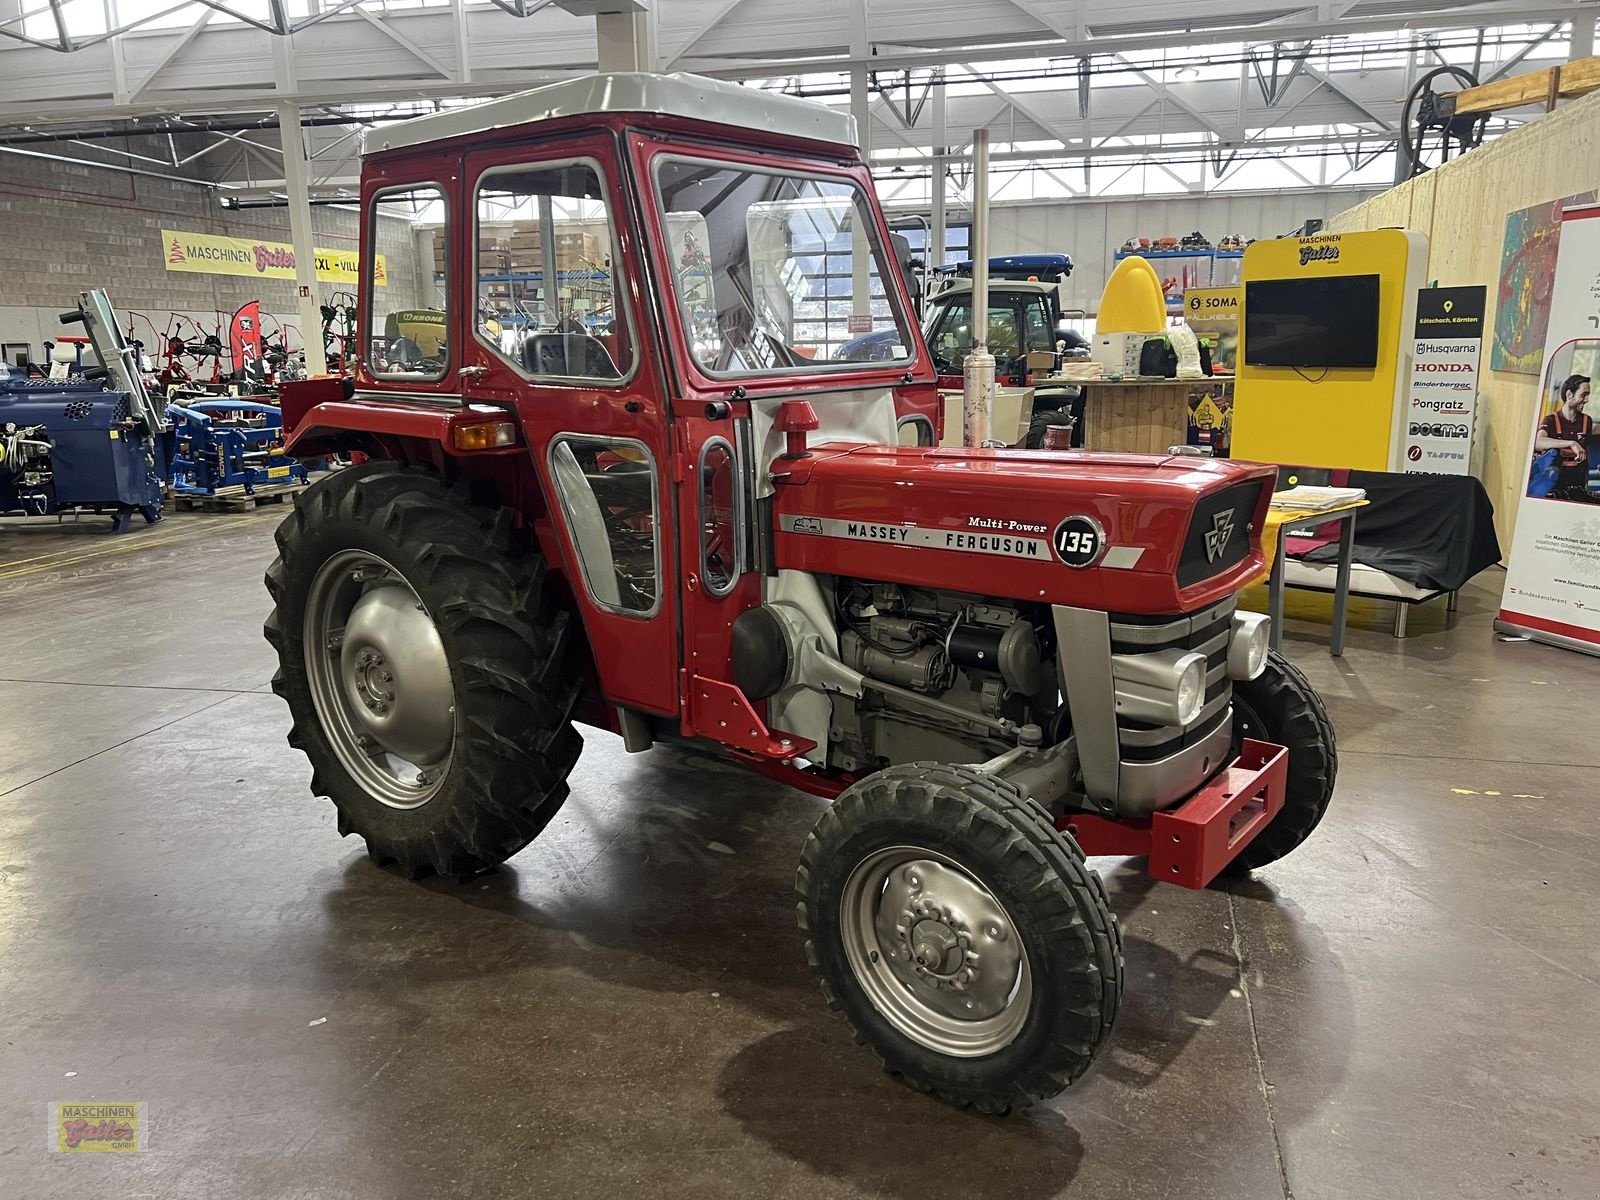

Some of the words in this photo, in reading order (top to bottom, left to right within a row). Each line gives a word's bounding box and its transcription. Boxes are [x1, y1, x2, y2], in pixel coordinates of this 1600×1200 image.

[1299, 235, 1341, 244] MASCHINEN
[186, 245, 251, 263] MASCHINEN
[1299, 245, 1339, 265] Gailer
[1206, 298, 1238, 308] SOMA
[1426, 344, 1476, 354] Husqvarna
[1414, 364, 1474, 372] HONDA
[1413, 381, 1471, 389] Binderberger
[1412, 398, 1464, 412] Pongratz
[968, 516, 1047, 533] Multi-Power
[848, 524, 908, 542] MASSEY
[946, 533, 1037, 556] FERGUSON
[1060, 531, 1094, 554] 135
